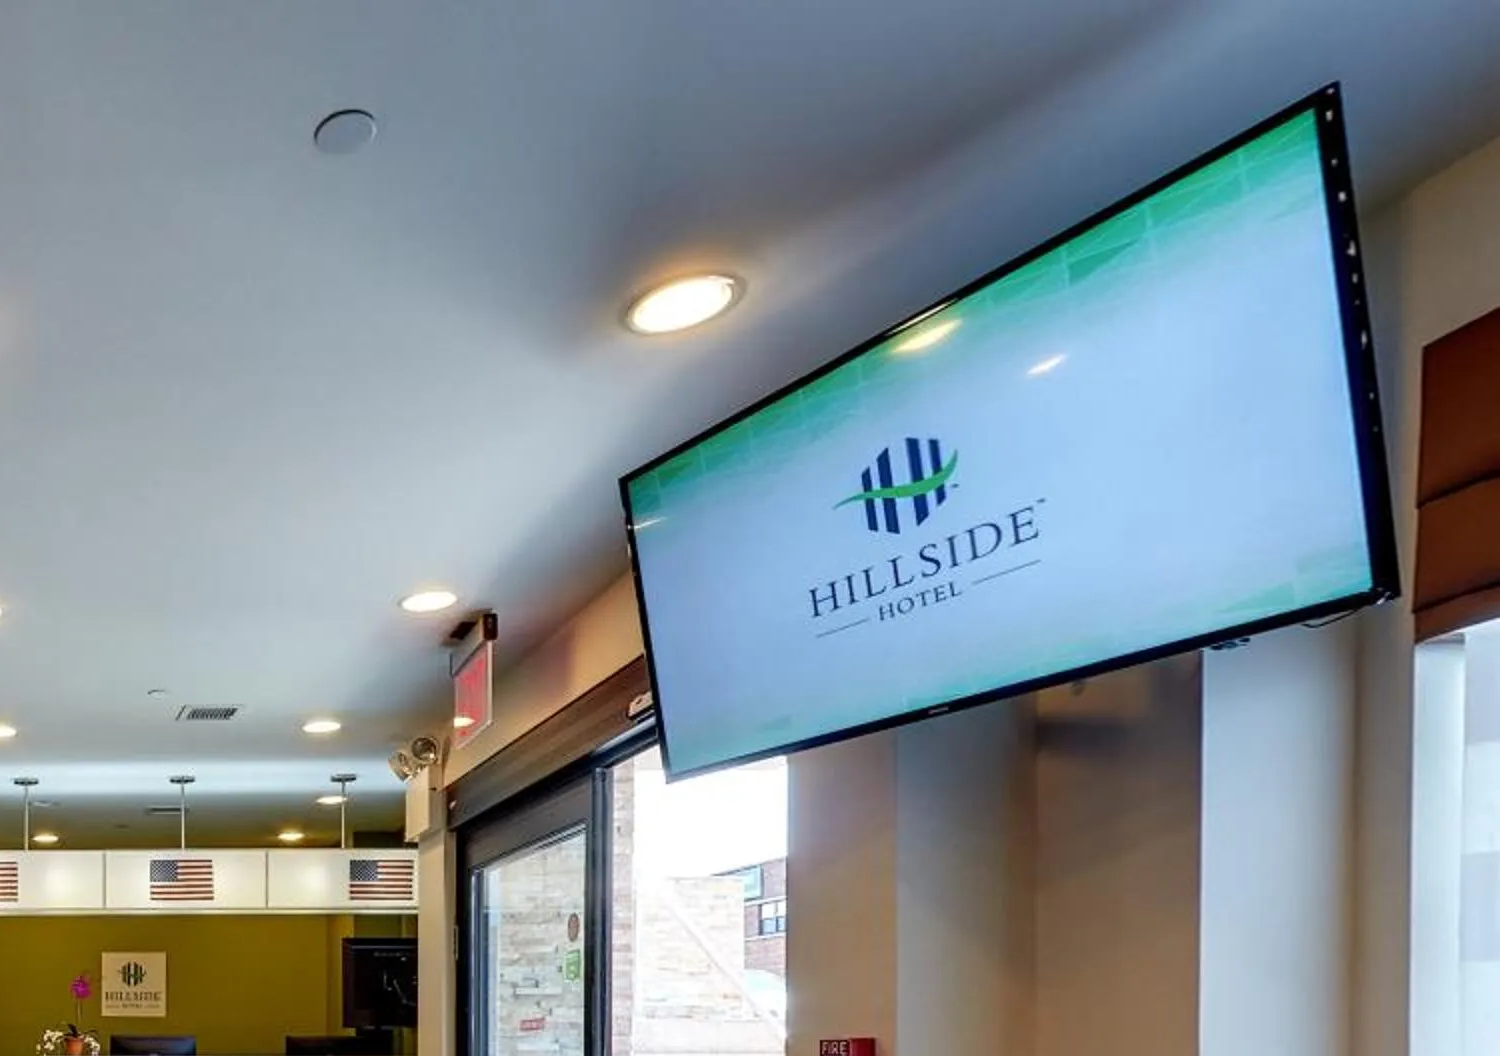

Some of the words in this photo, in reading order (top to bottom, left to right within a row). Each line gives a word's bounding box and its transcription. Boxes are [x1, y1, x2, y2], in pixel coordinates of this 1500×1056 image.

[809, 506, 1041, 619] HILLSIDE
[878, 581, 964, 621] HOTEL
[821, 1041, 847, 1055] FIRE
